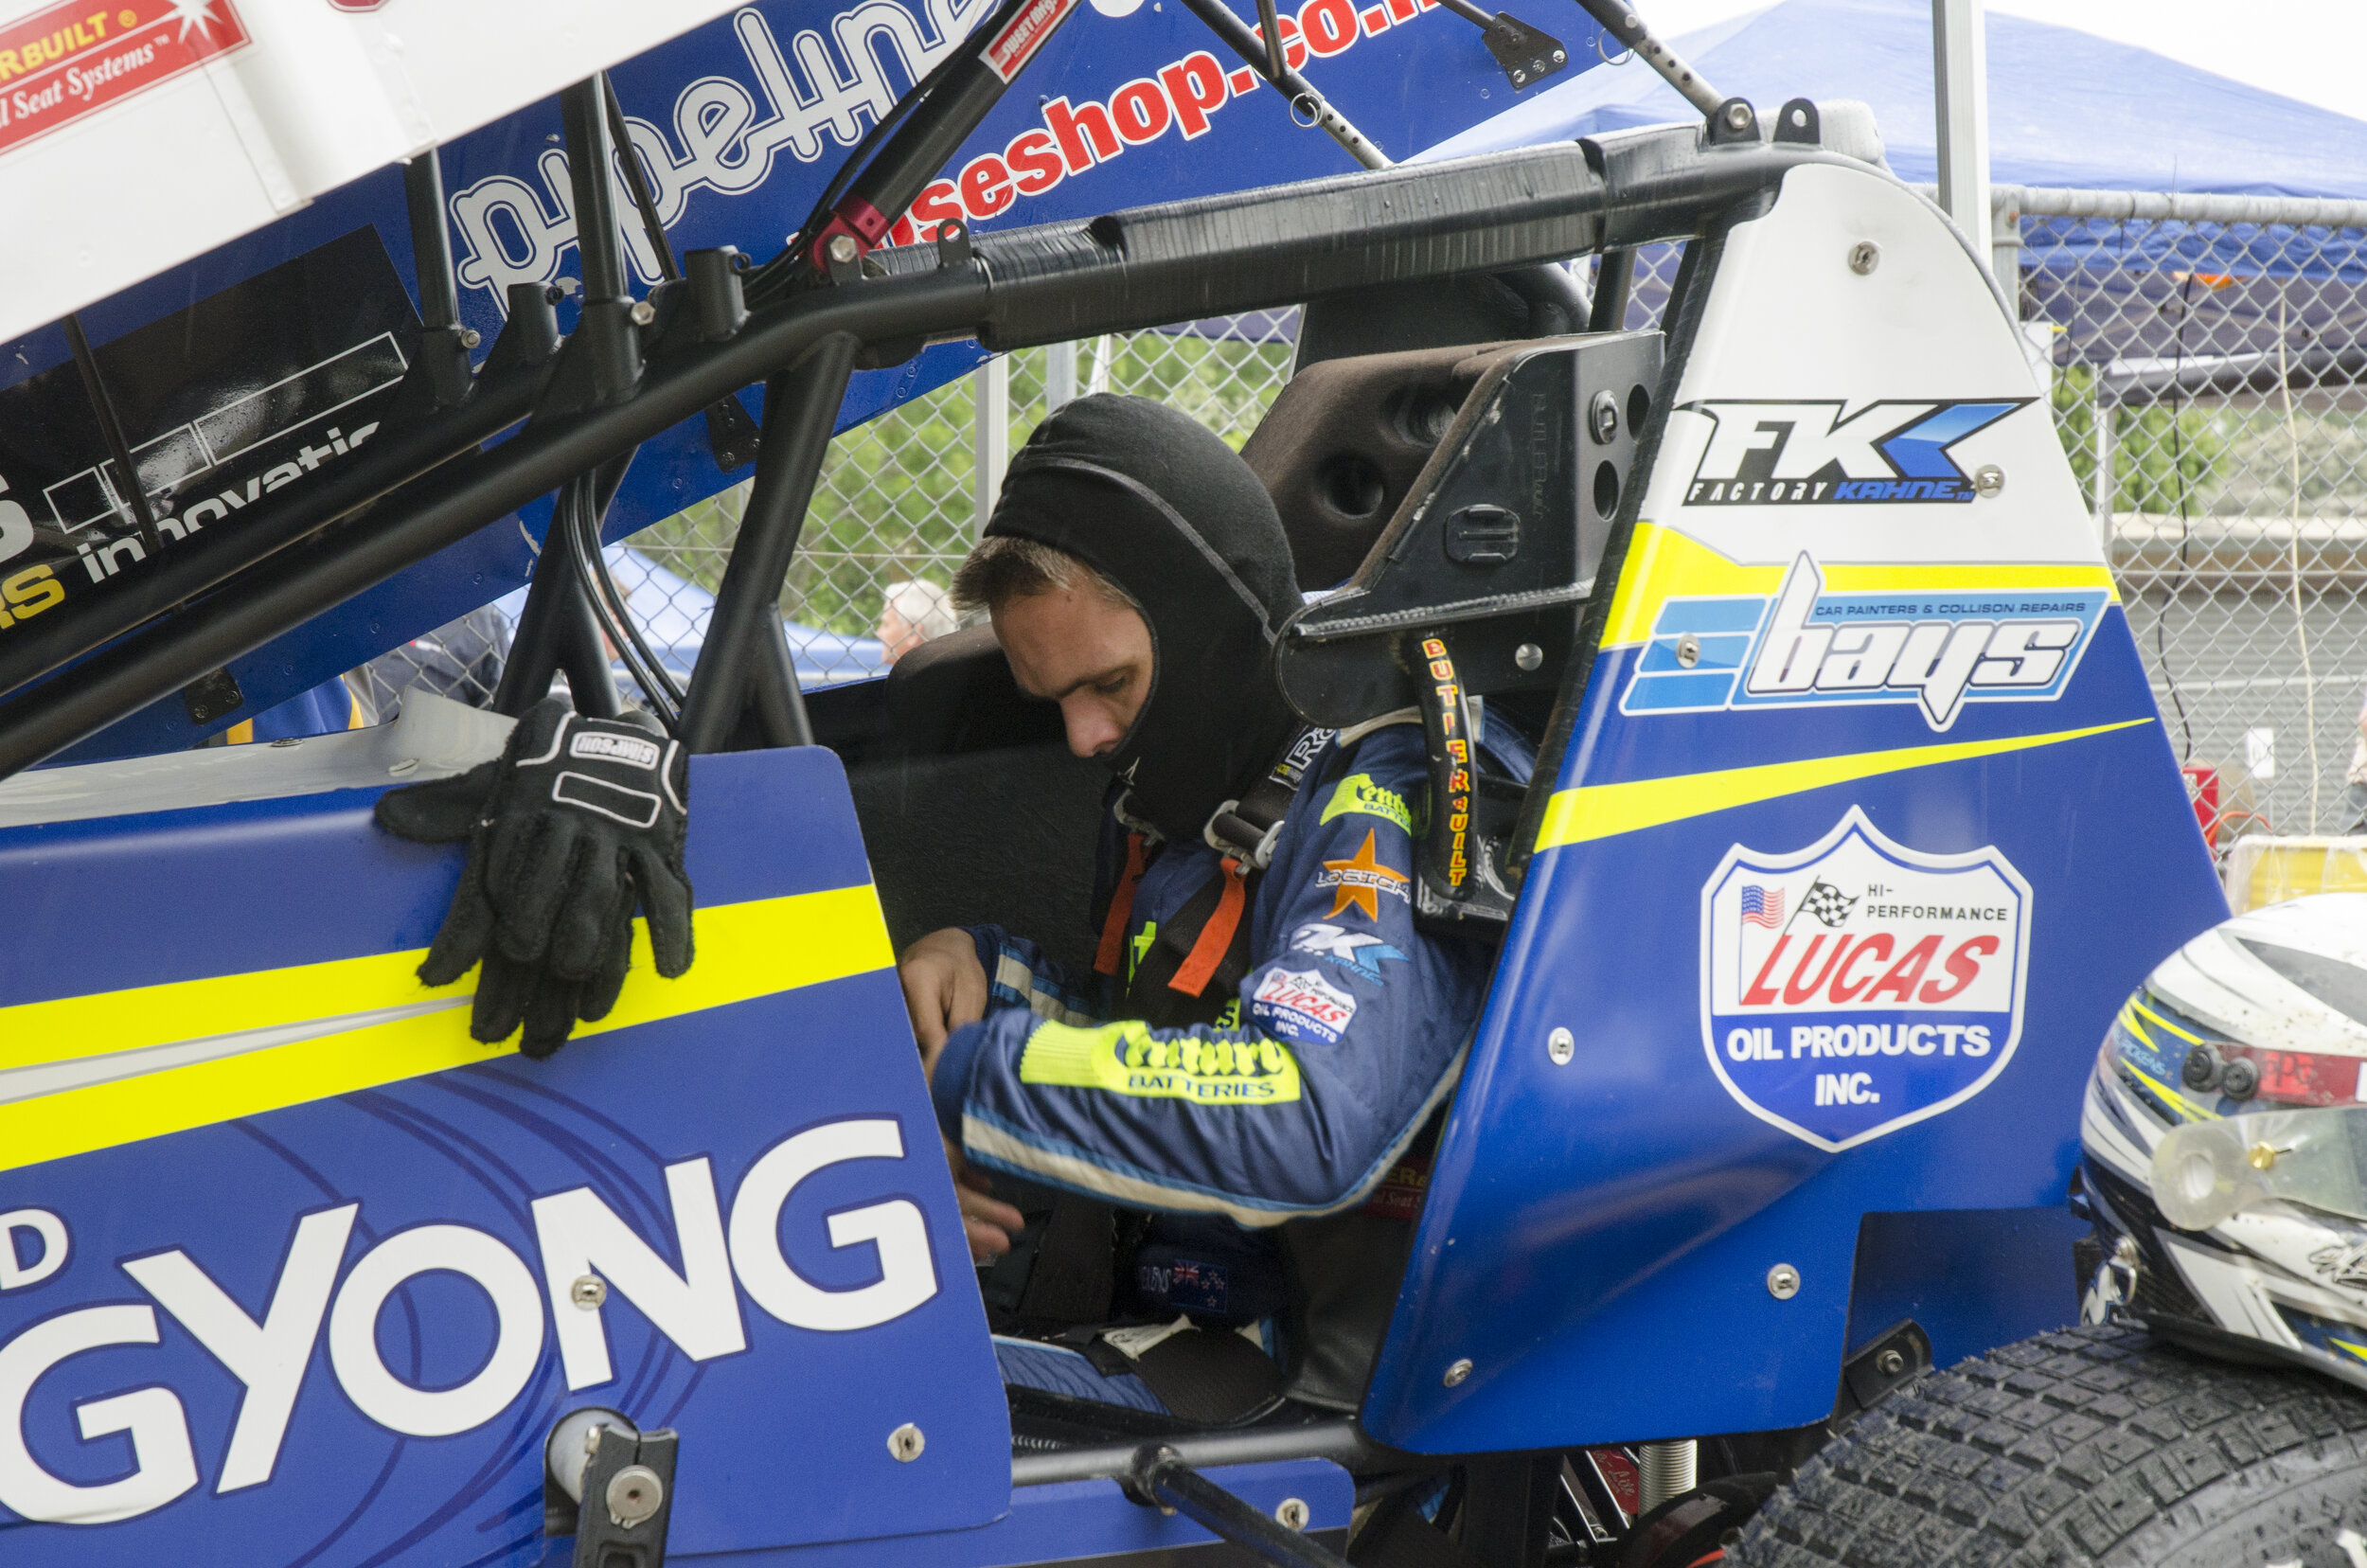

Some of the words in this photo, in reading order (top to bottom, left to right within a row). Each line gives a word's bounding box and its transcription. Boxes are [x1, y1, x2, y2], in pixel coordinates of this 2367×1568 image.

[12, 80, 64, 119] Seat
[1688, 481, 1829, 502] FACTORY
[1816, 606, 1843, 615] CAR
[1847, 604, 1918, 615] PAINTERS
[1923, 604, 1933, 615] &
[1938, 603, 2015, 615] COLLISON
[2020, 601, 2087, 614] REPAIRS
[576, 737, 654, 764] SIMPSON
[1866, 905, 2008, 921] PERFORMANCE
[1739, 932, 2001, 1007] LUCAS
[1261, 983, 1347, 1023] LUCAS
[1271, 1006, 1338, 1043] PRODUCTS
[1726, 1027, 1784, 1061] OIL
[1790, 1024, 1992, 1060] PRODUCTS
[1128, 1073, 1276, 1099] BATTERIES
[1814, 1072, 1881, 1107] INC.
